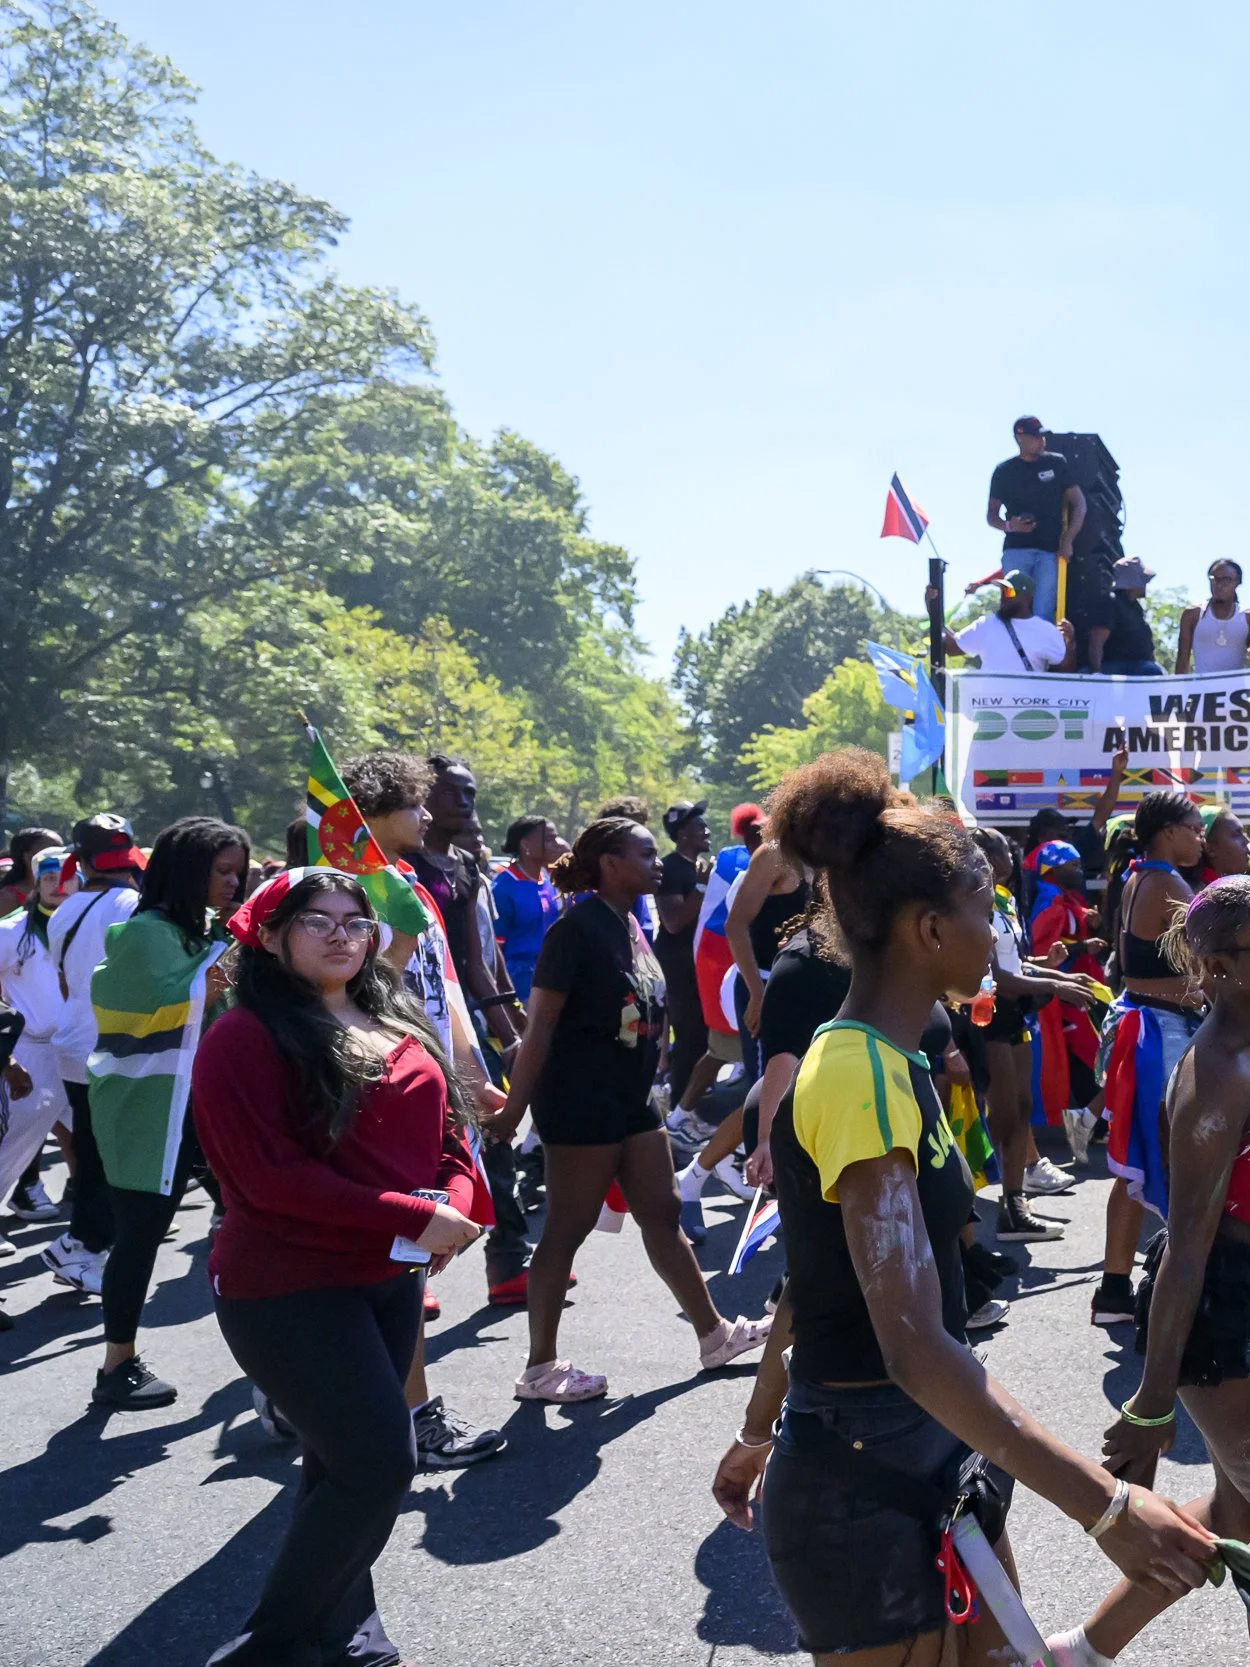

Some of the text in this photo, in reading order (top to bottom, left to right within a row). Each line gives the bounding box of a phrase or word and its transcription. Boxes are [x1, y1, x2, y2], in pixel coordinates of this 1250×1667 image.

[972, 697, 1003, 706] NEW
[1012, 697, 1050, 706] YORK
[973, 709, 1089, 741] DOT
